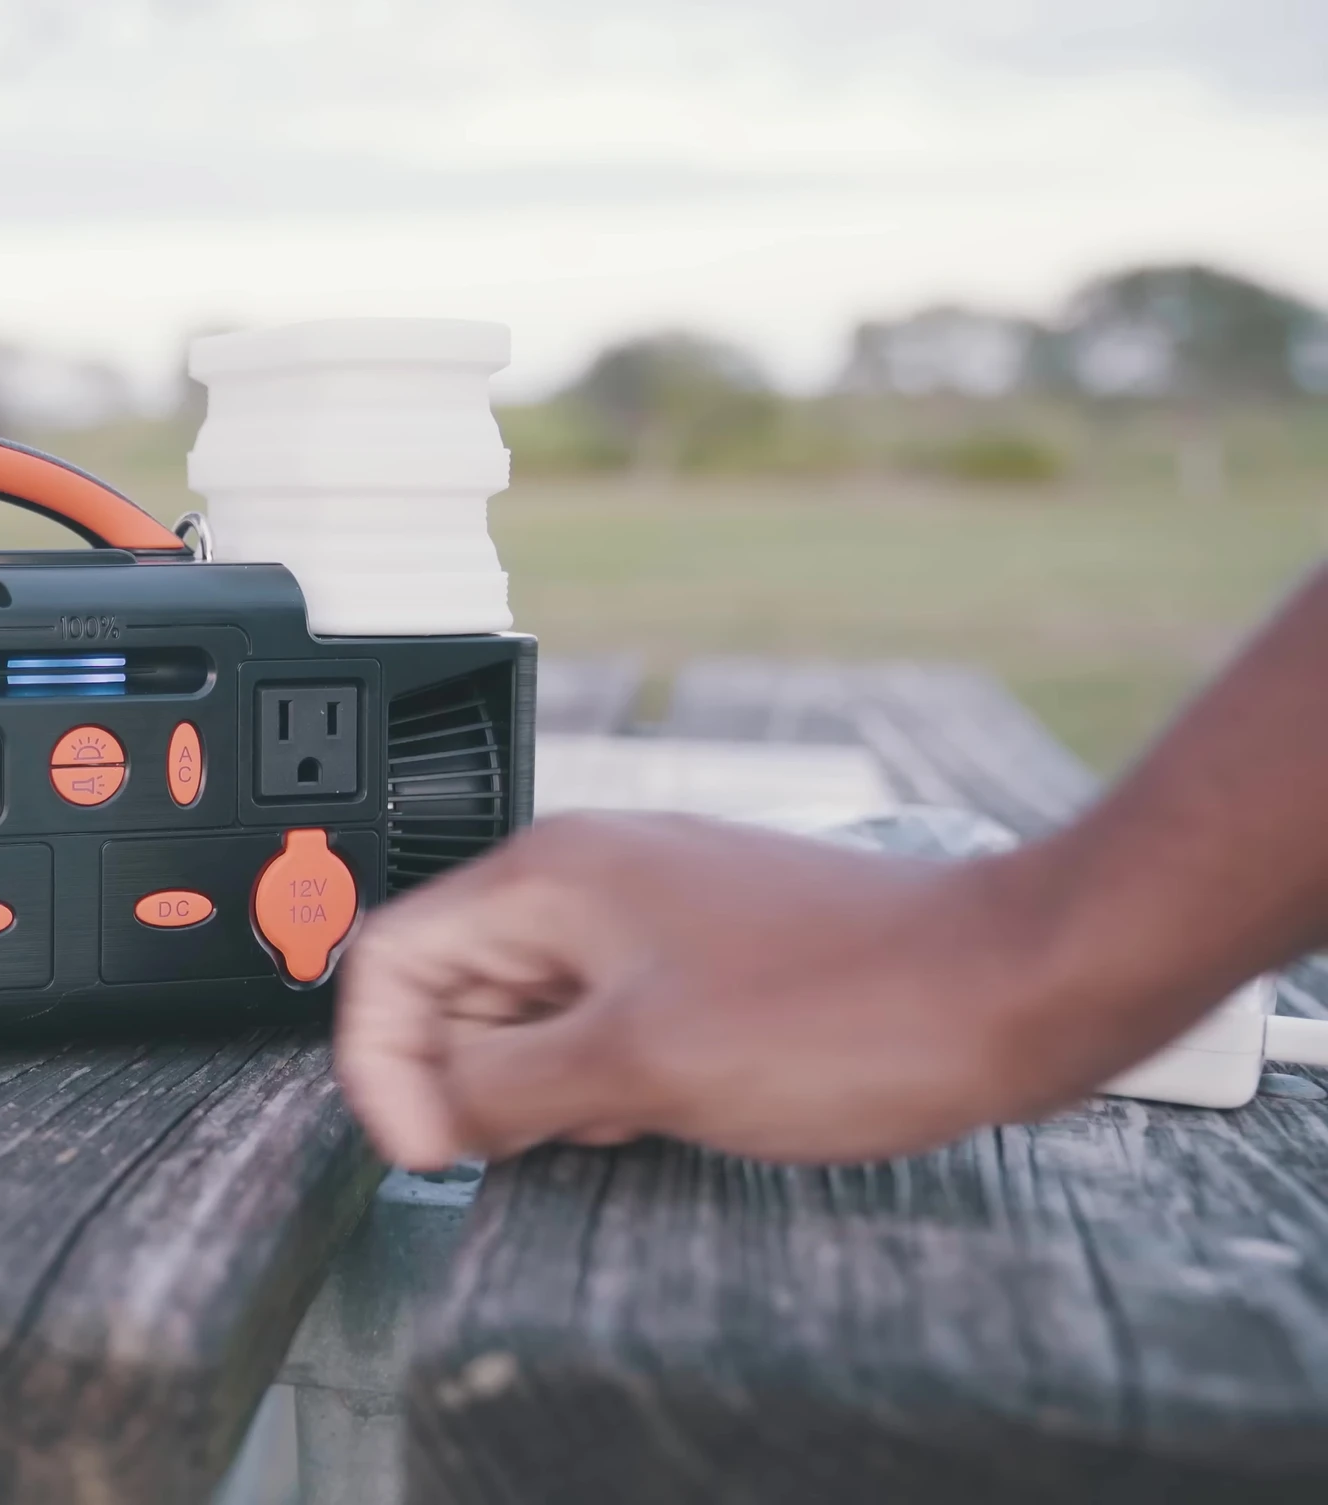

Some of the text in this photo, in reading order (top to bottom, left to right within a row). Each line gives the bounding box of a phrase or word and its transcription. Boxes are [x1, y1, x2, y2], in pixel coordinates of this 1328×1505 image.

[60, 615, 120, 640] 100%
[289, 878, 328, 898] 12V
[158, 900, 190, 918] DC
[289, 904, 327, 924] 10A
